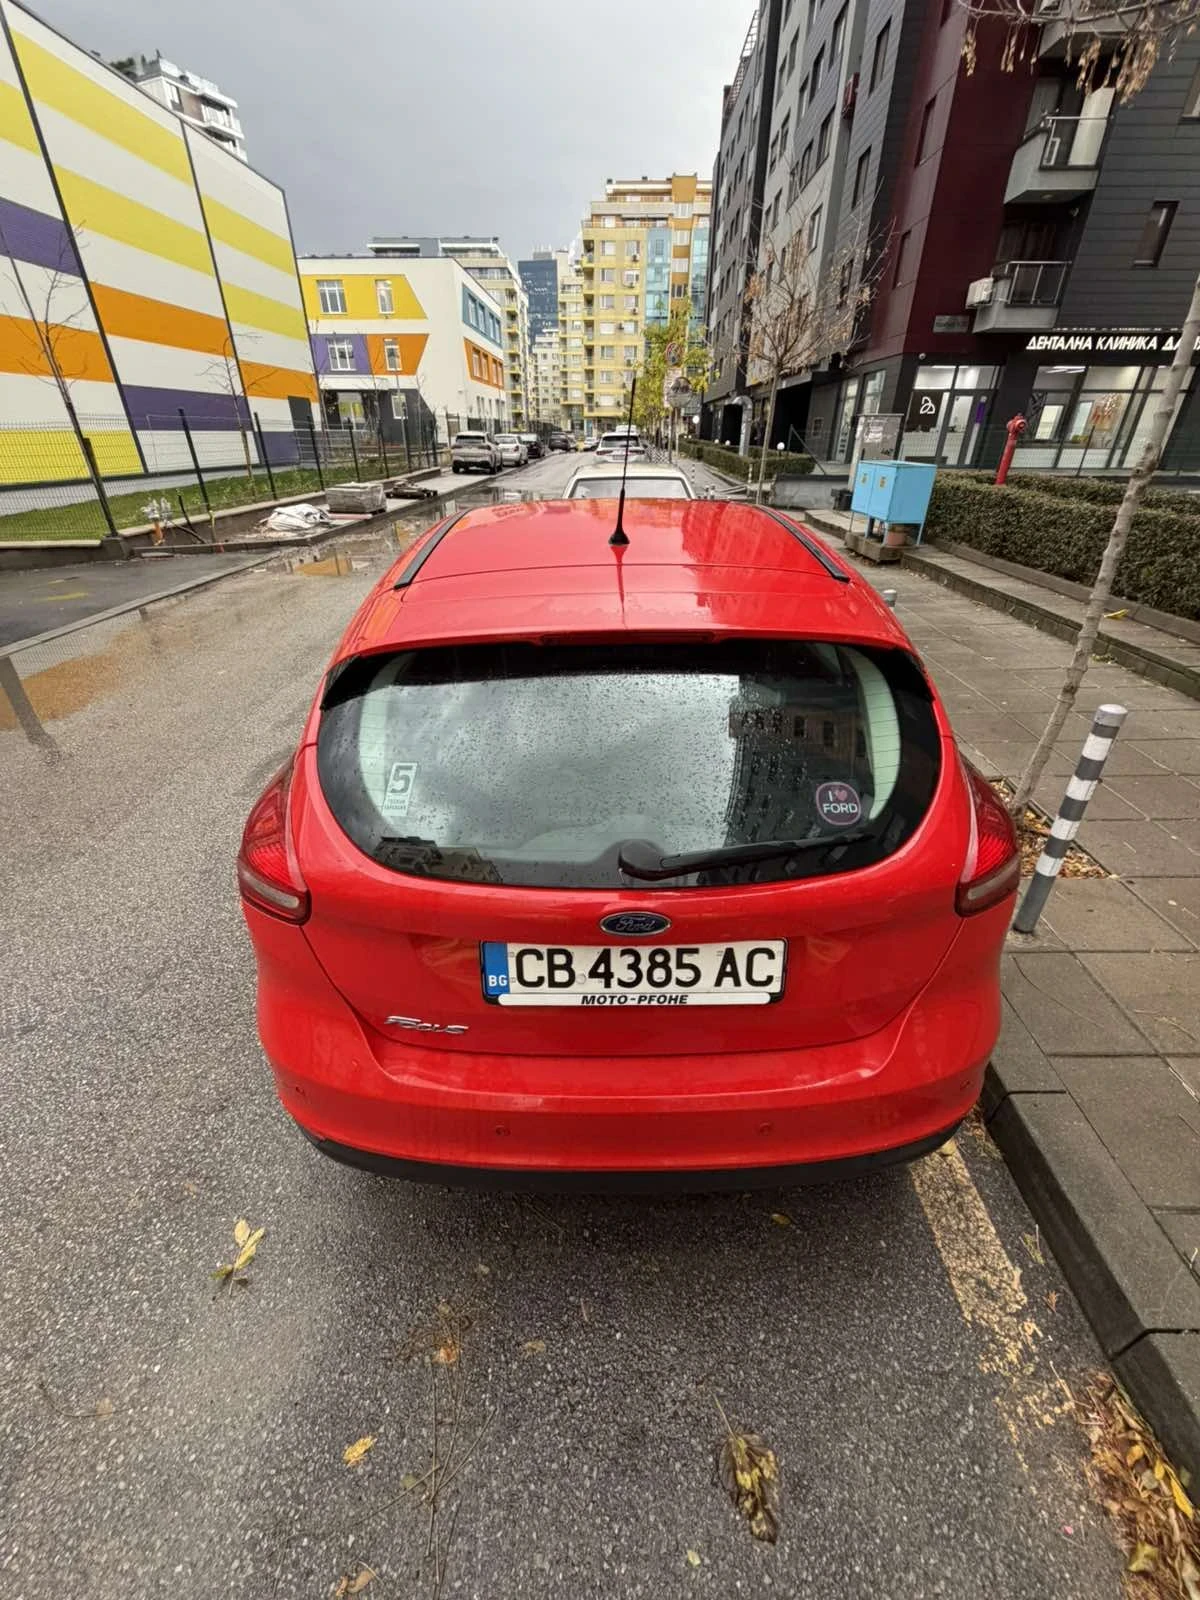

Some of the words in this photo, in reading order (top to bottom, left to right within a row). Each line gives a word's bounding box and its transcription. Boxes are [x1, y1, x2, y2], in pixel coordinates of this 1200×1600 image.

[1026, 335, 1092, 350] ДЕНТАЛНА
[1096, 335, 1158, 350] КЛИНИКА
[389, 765, 411, 794] 5
[828, 790, 833, 802] I
[823, 803, 858, 814] FORD
[616, 915, 656, 931] Ford
[515, 947, 576, 989] CB
[587, 947, 702, 989] 4385
[713, 947, 777, 988] AC
[488, 975, 508, 987] BG
[580, 994, 689, 1005] MOTO-PFOHE
